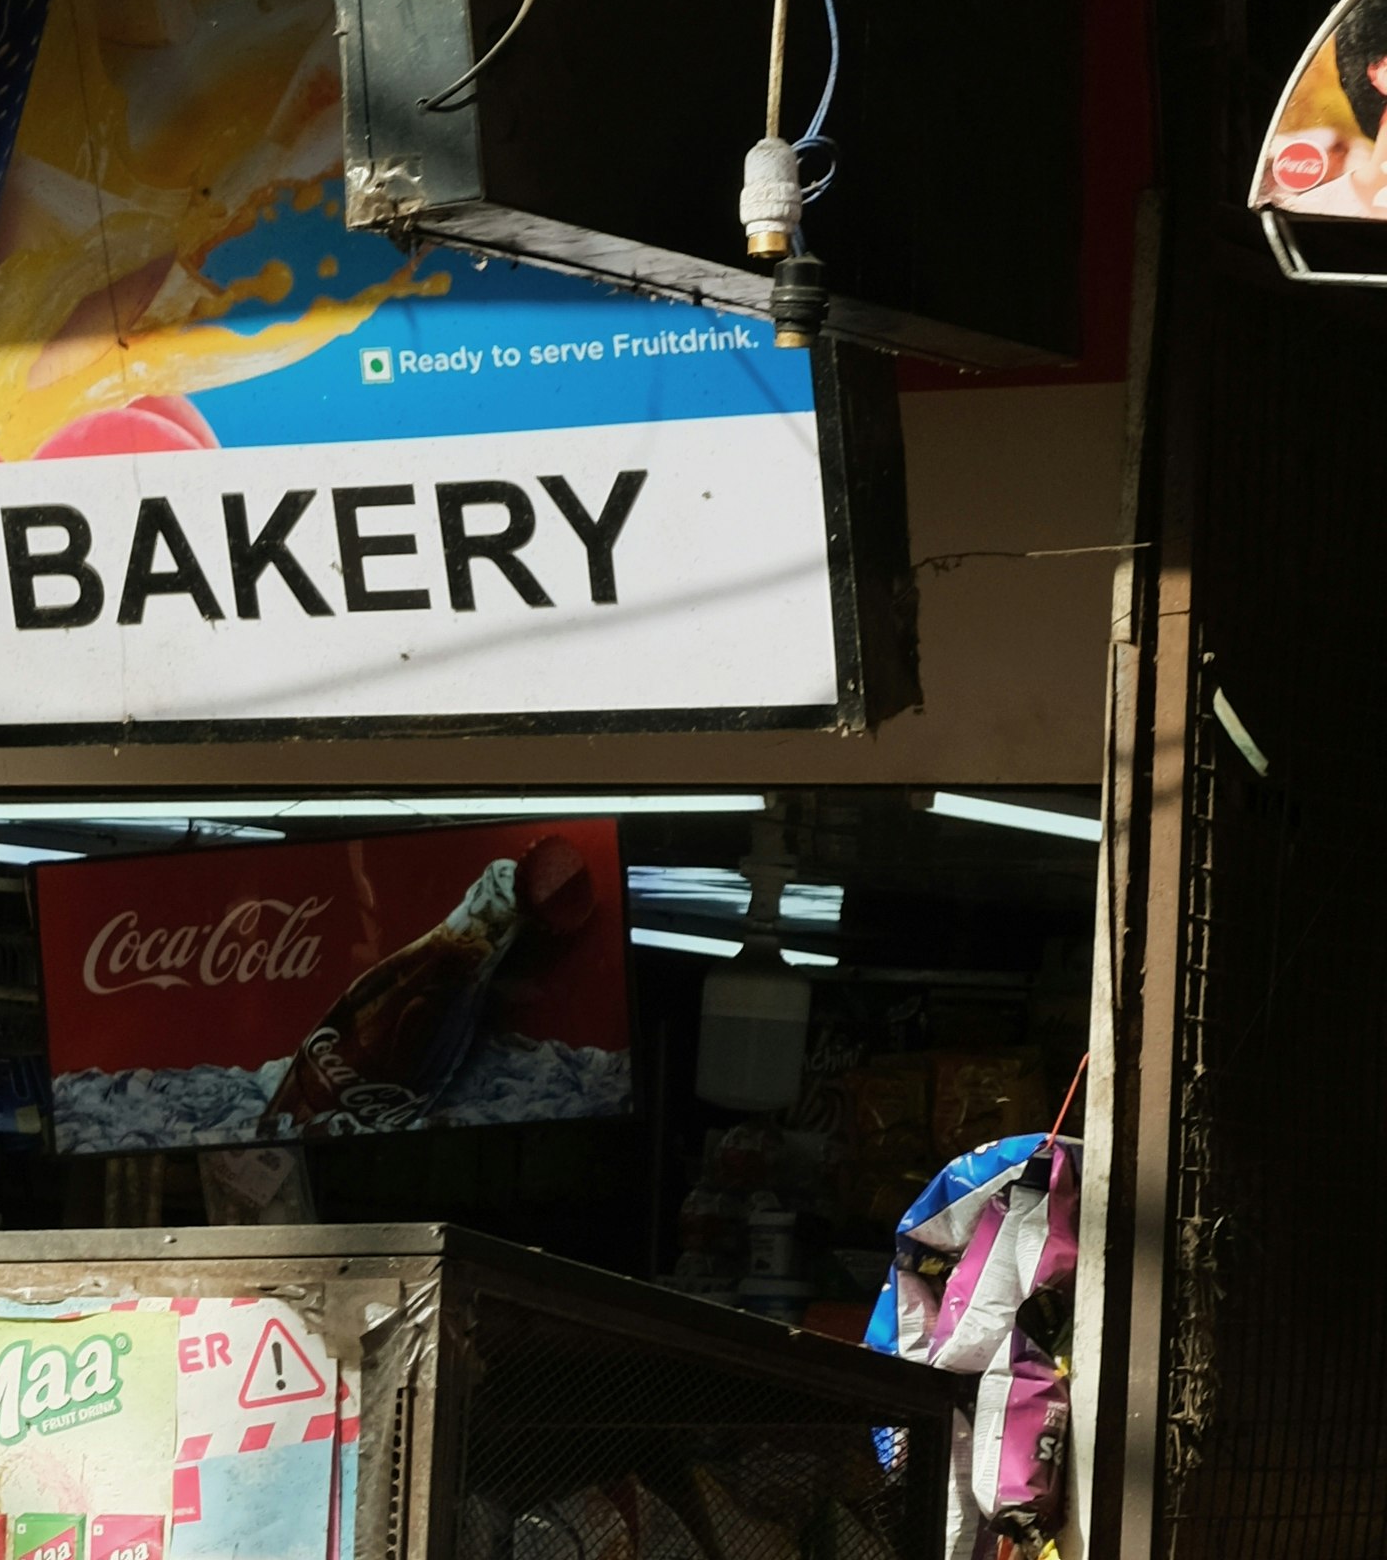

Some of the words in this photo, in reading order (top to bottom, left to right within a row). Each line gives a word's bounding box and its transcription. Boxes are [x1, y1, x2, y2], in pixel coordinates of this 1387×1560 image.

[399, 345, 482, 380] Ready
[492, 344, 521, 368] to
[530, 340, 604, 366] serve
[613, 324, 760, 360] Fruitdrink.
[0, 469, 649, 631] BAKERY
[83, 894, 335, 996] Coca-Cola
[41, 1410, 76, 1433] FRUIT
[79, 1401, 116, 1421] DRINK
